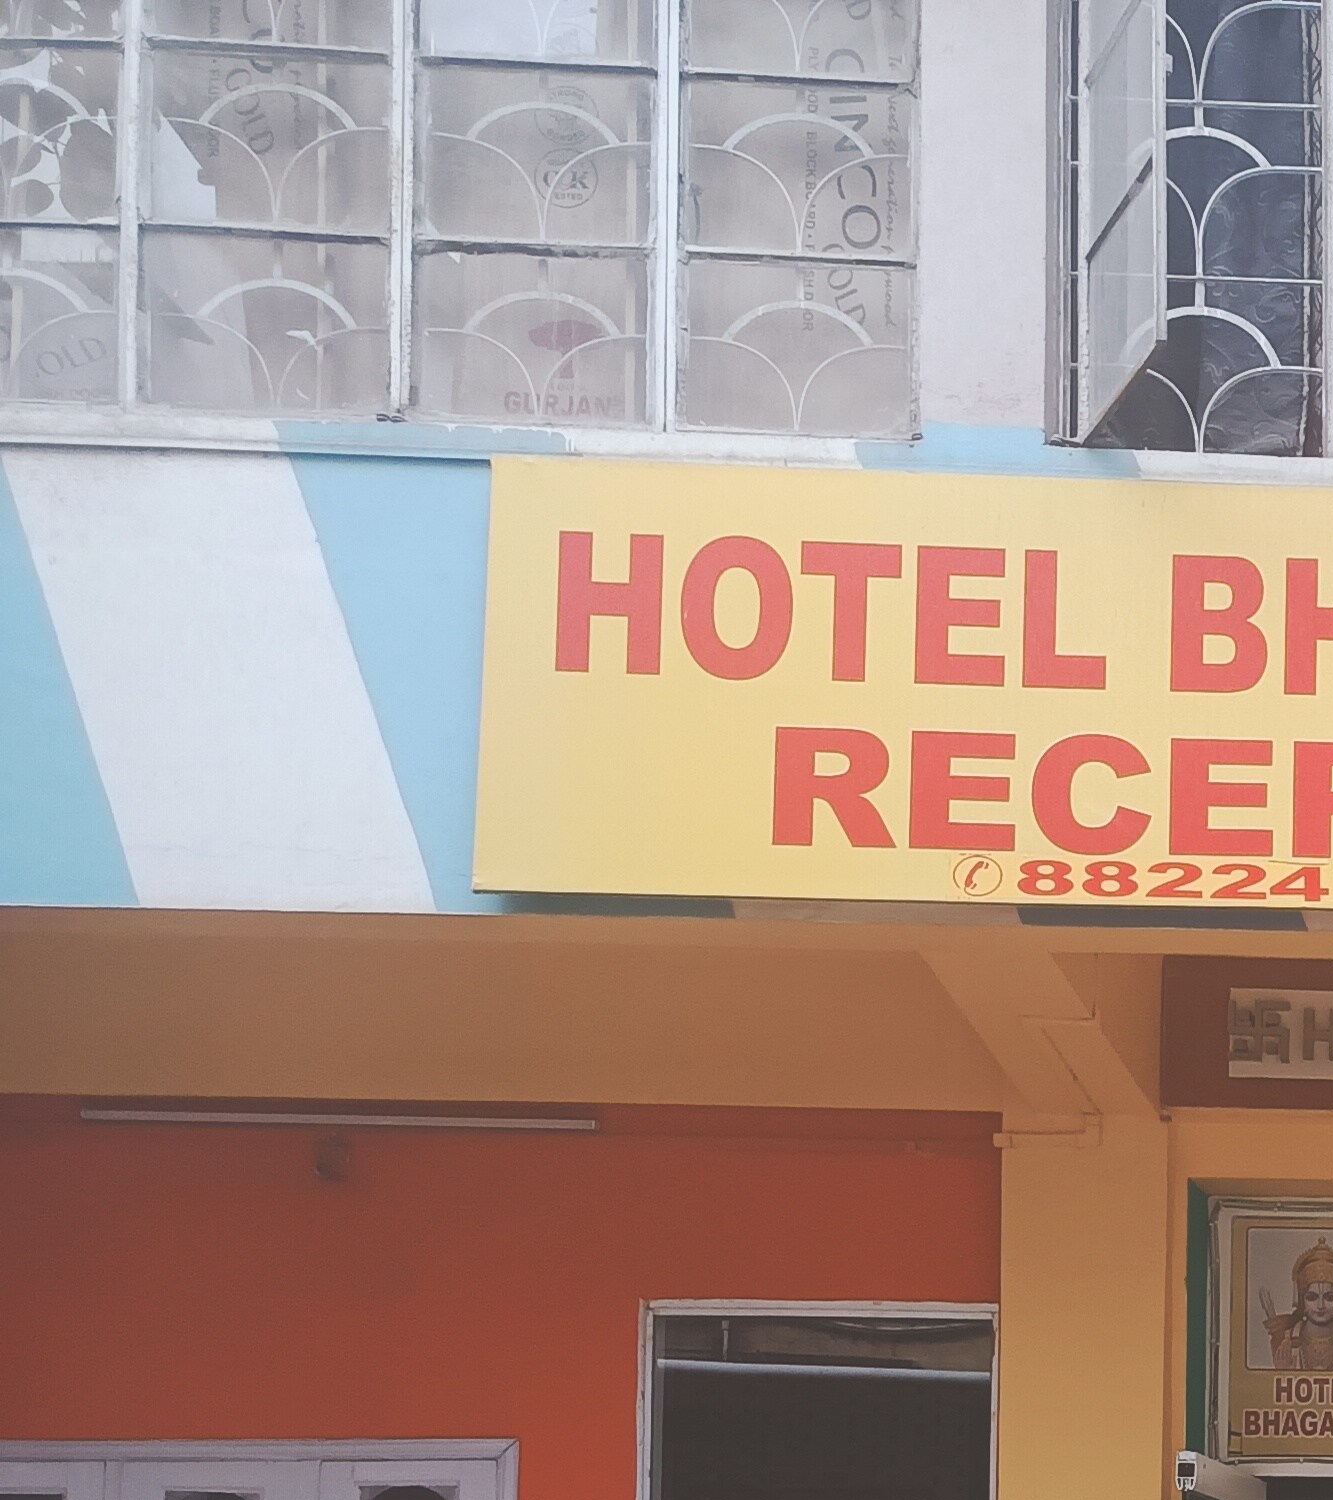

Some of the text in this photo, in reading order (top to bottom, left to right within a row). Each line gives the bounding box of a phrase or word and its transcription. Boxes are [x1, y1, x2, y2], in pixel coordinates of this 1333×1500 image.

[825, 48, 882, 250] CINCO
[34, 336, 108, 379] OLD
[554, 530, 1107, 691] HOTEL
[1016, 859, 1329, 904] 88224
